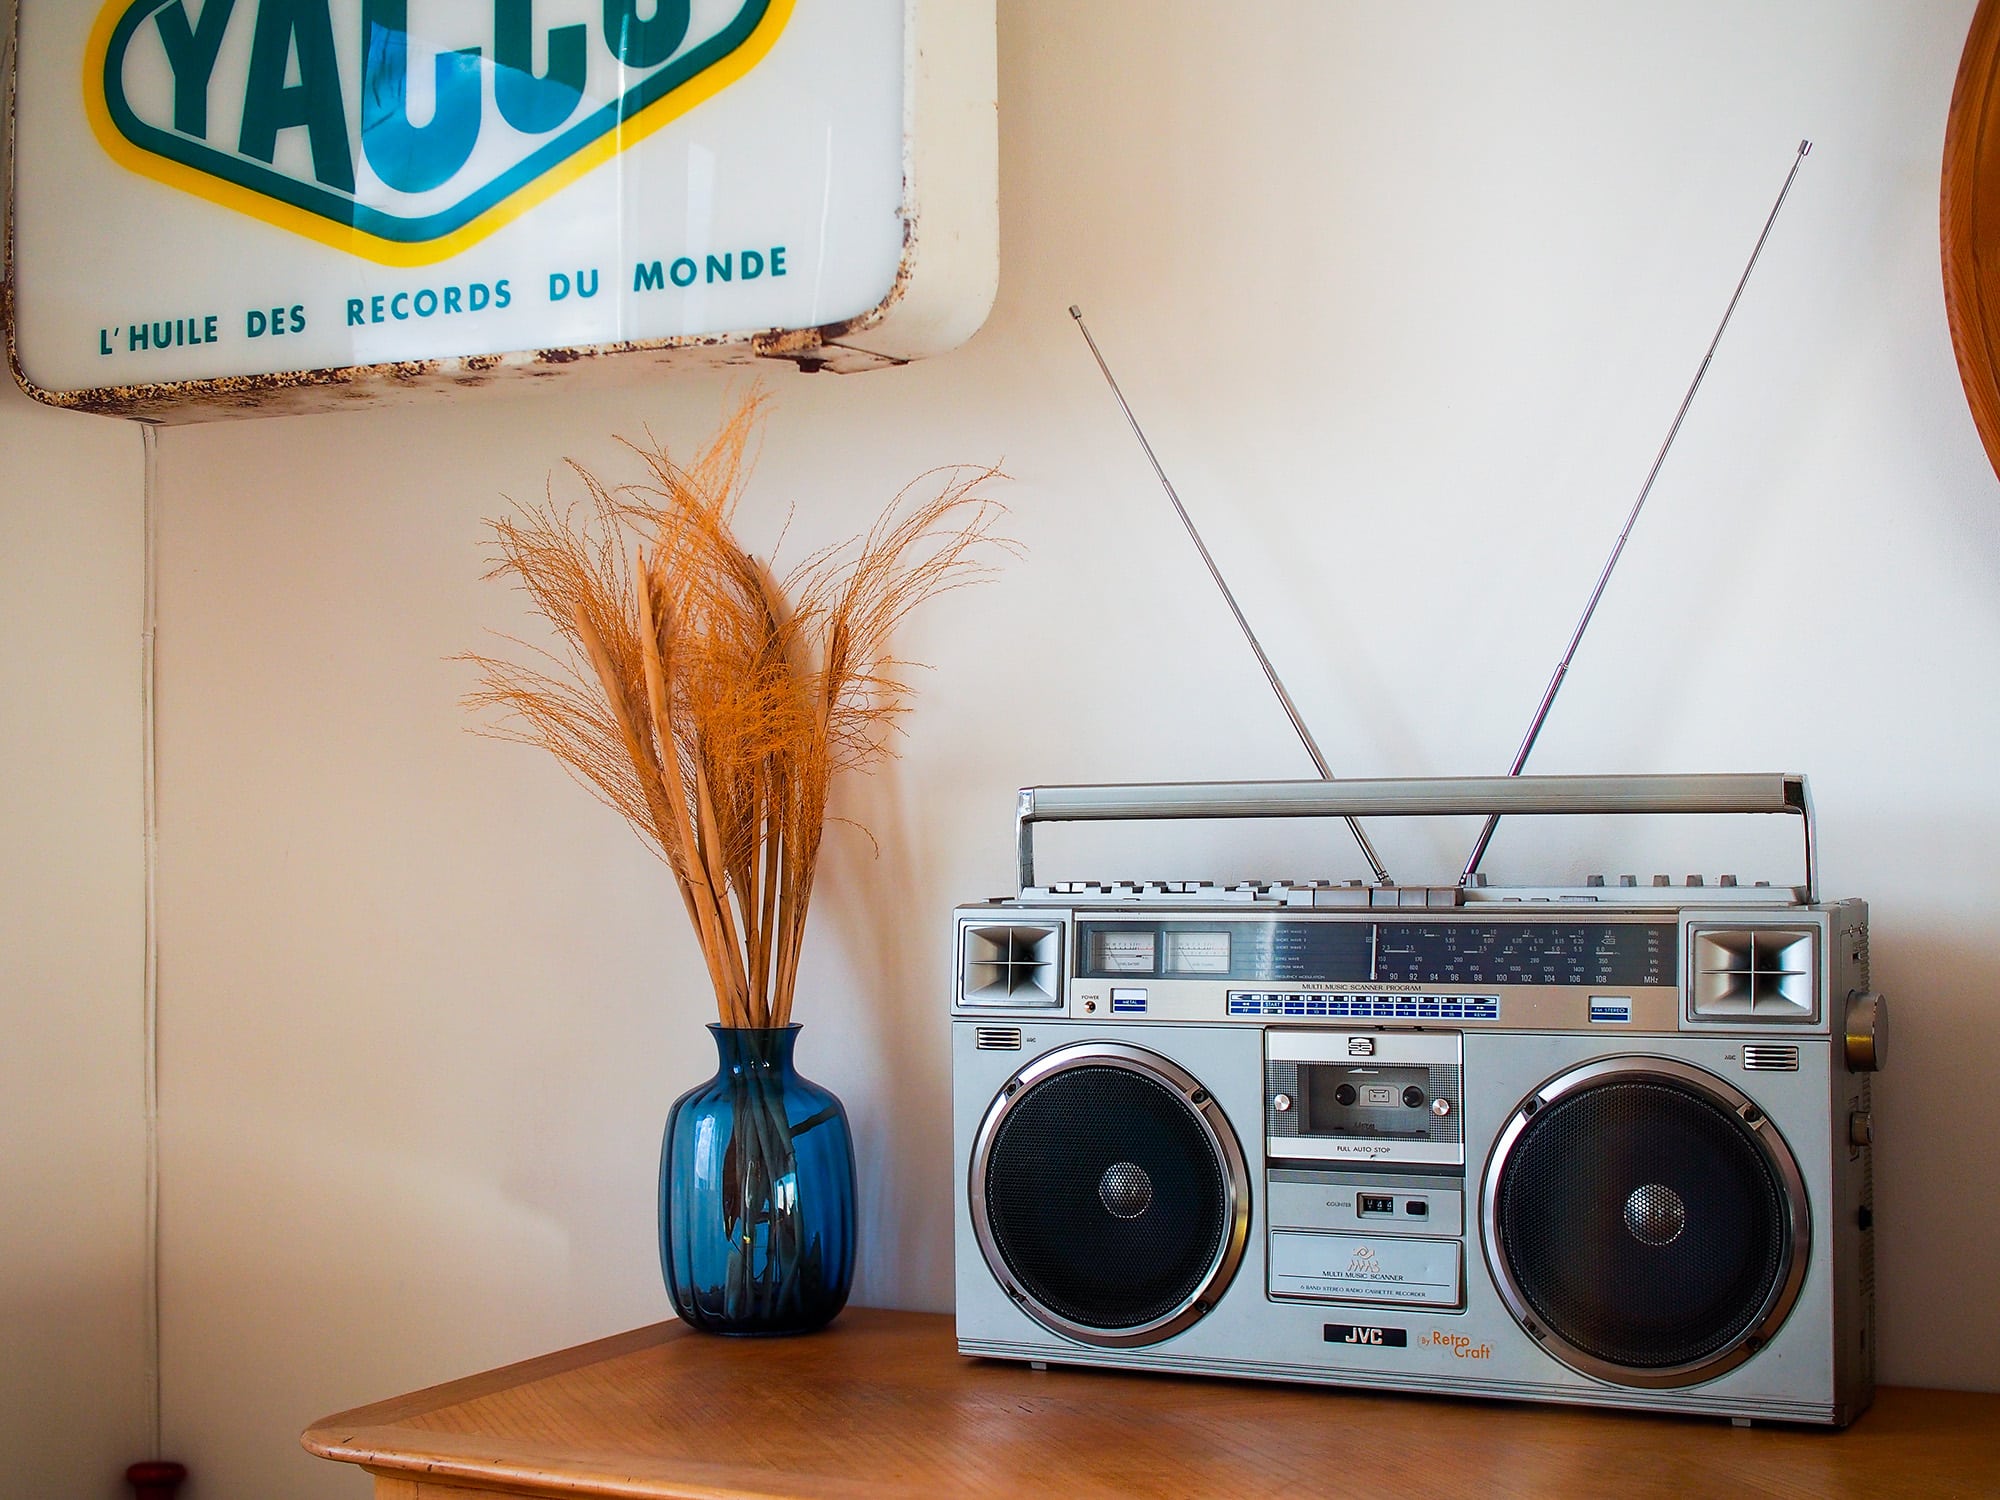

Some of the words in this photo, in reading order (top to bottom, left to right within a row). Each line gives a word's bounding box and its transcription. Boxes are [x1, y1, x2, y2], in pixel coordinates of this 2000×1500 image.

[100, 316, 218, 355] L'HUILE
[247, 304, 306, 338] DES
[347, 279, 512, 326] RECORDS
[550, 269, 598, 301] DU
[633, 246, 786, 292] MONDE
[1409, 973, 1418, 981] 92
[1430, 973, 1439, 981] 94
[1450, 973, 1459, 981] 96
[1473, 974, 1483, 982] 98
[1496, 974, 1508, 982] 100
[1521, 974, 1532, 982] 102
[1544, 974, 1555, 983] 104
[1569, 975, 1581, 983] 106
[1595, 975, 1607, 983] 108
[1643, 975, 1659, 984] MHz
[1370, 1273, 1404, 1281] SCANNER
[1345, 1327, 1383, 1345] JVC
[1433, 1331, 1470, 1347] Retro
[1454, 1343, 1491, 1359] Craft
